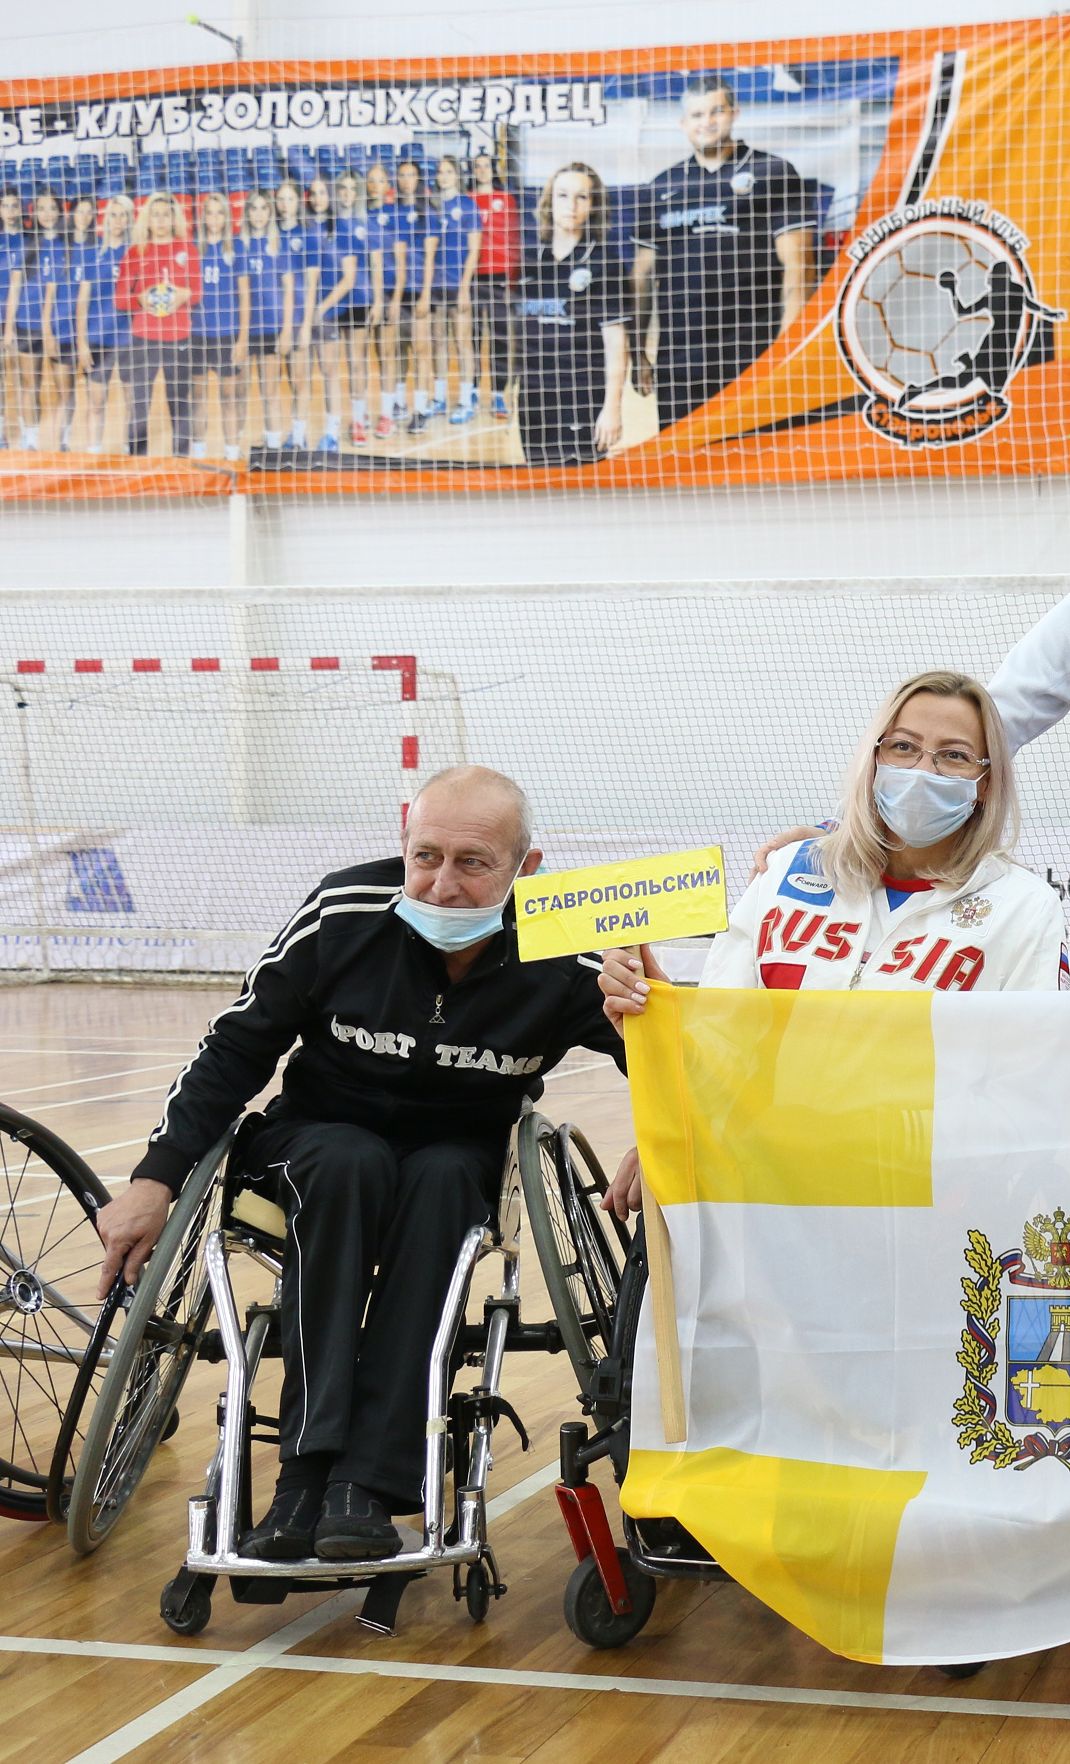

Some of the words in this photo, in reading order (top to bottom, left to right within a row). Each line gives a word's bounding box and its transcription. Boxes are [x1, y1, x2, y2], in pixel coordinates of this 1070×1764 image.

[75, 96, 190, 140] КЛУБ
[199, 87, 420, 132] ЗОЛОТЫХ
[426, 82, 607, 127] СЕРДЕЦ
[850, 198, 986, 260] ГАНДБОЛЬНЫЙ
[991, 211, 1027, 251] КЛУБ
[524, 866, 720, 914] СТАВРОПОЛЬСКИЙ
[595, 907, 650, 933] КРАЙ
[435, 1044, 544, 1075] TEAMS
